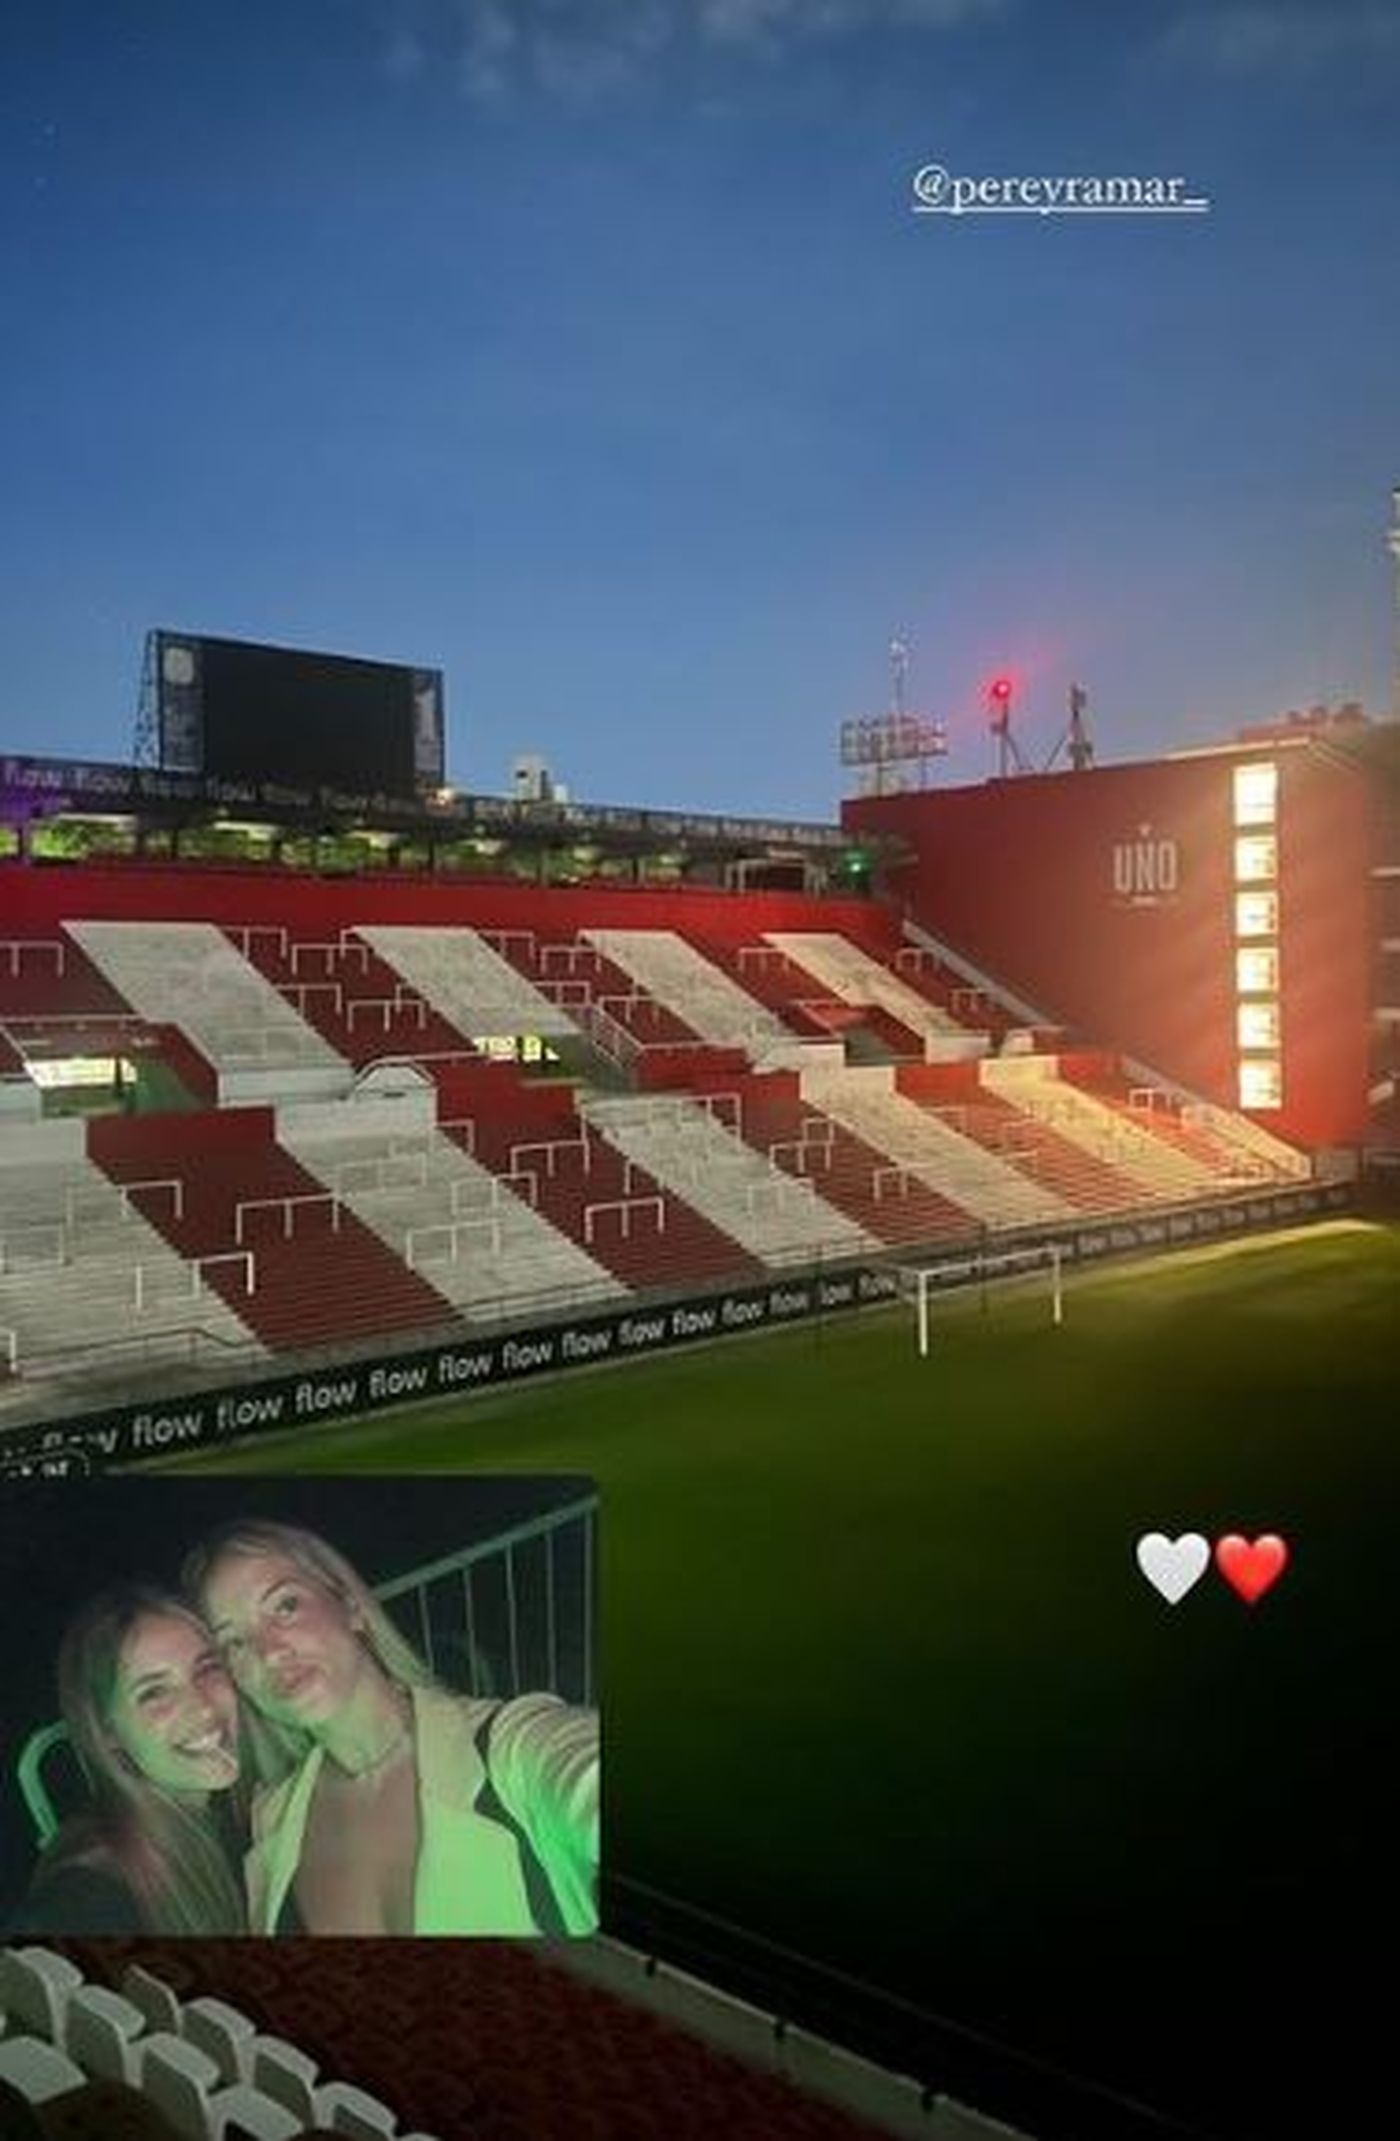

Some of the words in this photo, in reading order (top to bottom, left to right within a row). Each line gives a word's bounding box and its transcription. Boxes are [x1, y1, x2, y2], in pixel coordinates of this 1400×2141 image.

[1113, 840, 1177, 892] UNO
[132, 1411, 202, 1447] flow
[217, 1396, 283, 1431] flow
[295, 1380, 357, 1414] flow
[369, 1367, 428, 1398] flow
[438, 1353, 494, 1384] flow
[502, 1341, 553, 1370] flow
[561, 1329, 612, 1357] flow
[617, 1318, 665, 1346] flow
[672, 1309, 716, 1335] flow
[721, 1298, 764, 1325] flow
